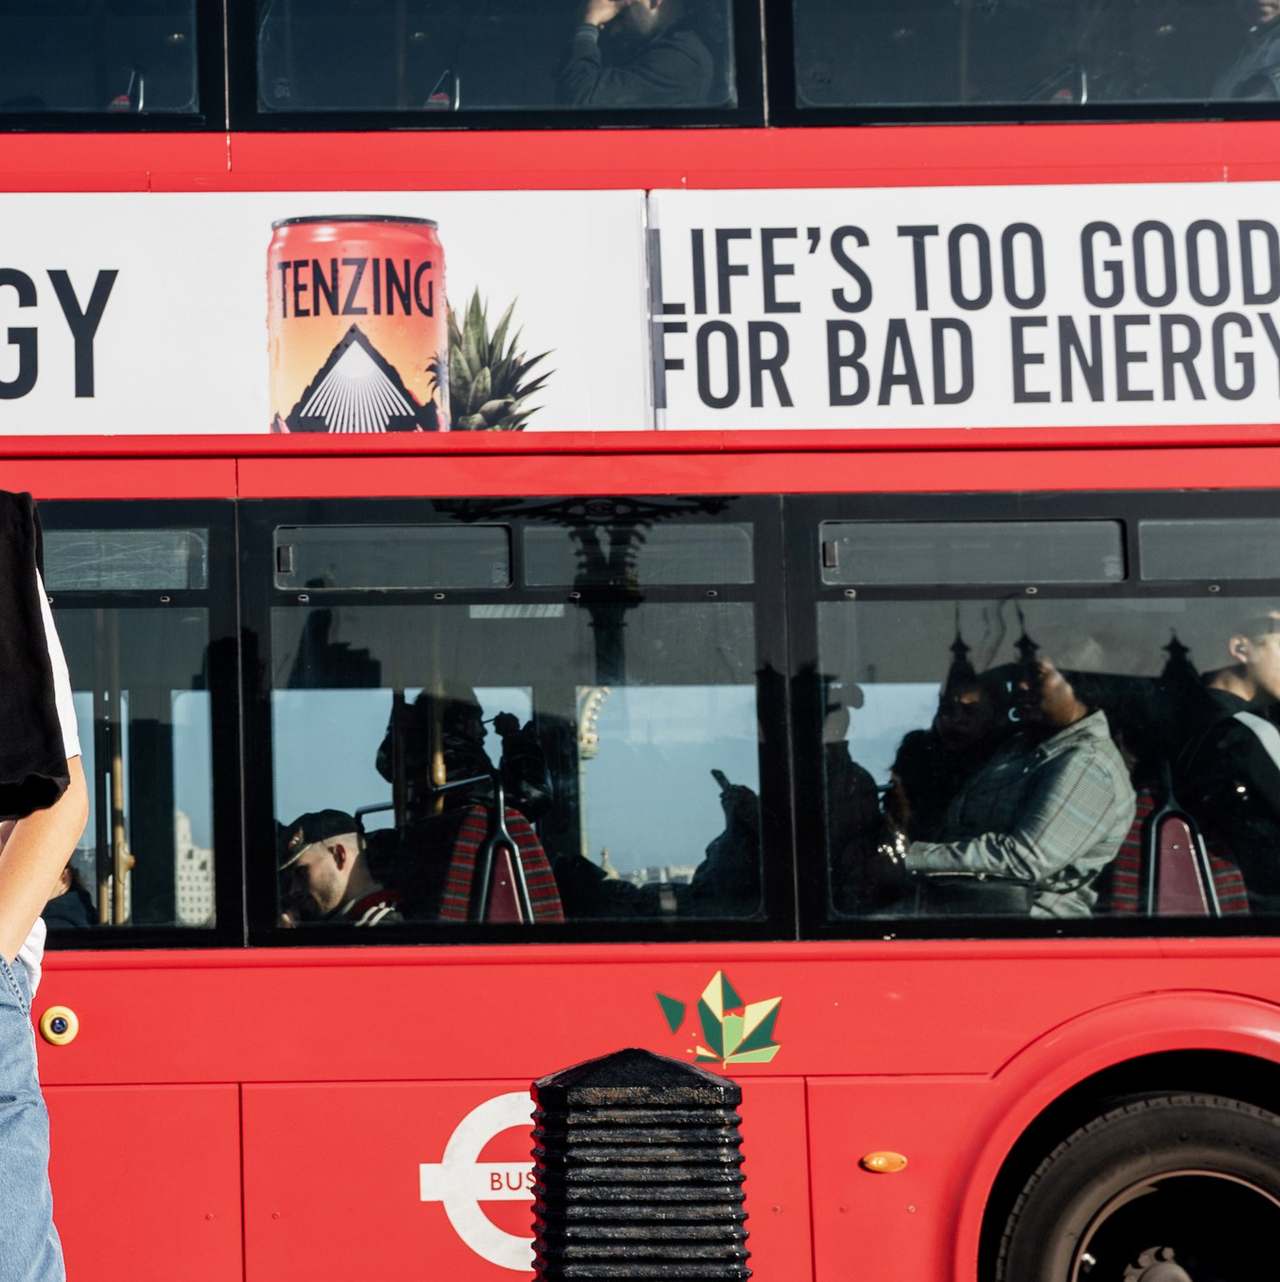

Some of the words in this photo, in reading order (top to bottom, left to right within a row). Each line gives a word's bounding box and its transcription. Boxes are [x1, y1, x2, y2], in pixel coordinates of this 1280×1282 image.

[277, 257, 435, 319] TENZING
[648, 224, 874, 316] LIFE'S
[897, 222, 1048, 312] TOO
[1080, 219, 1280, 309] GOOD
[651, 320, 795, 410] FOR
[826, 317, 976, 408] BAD
